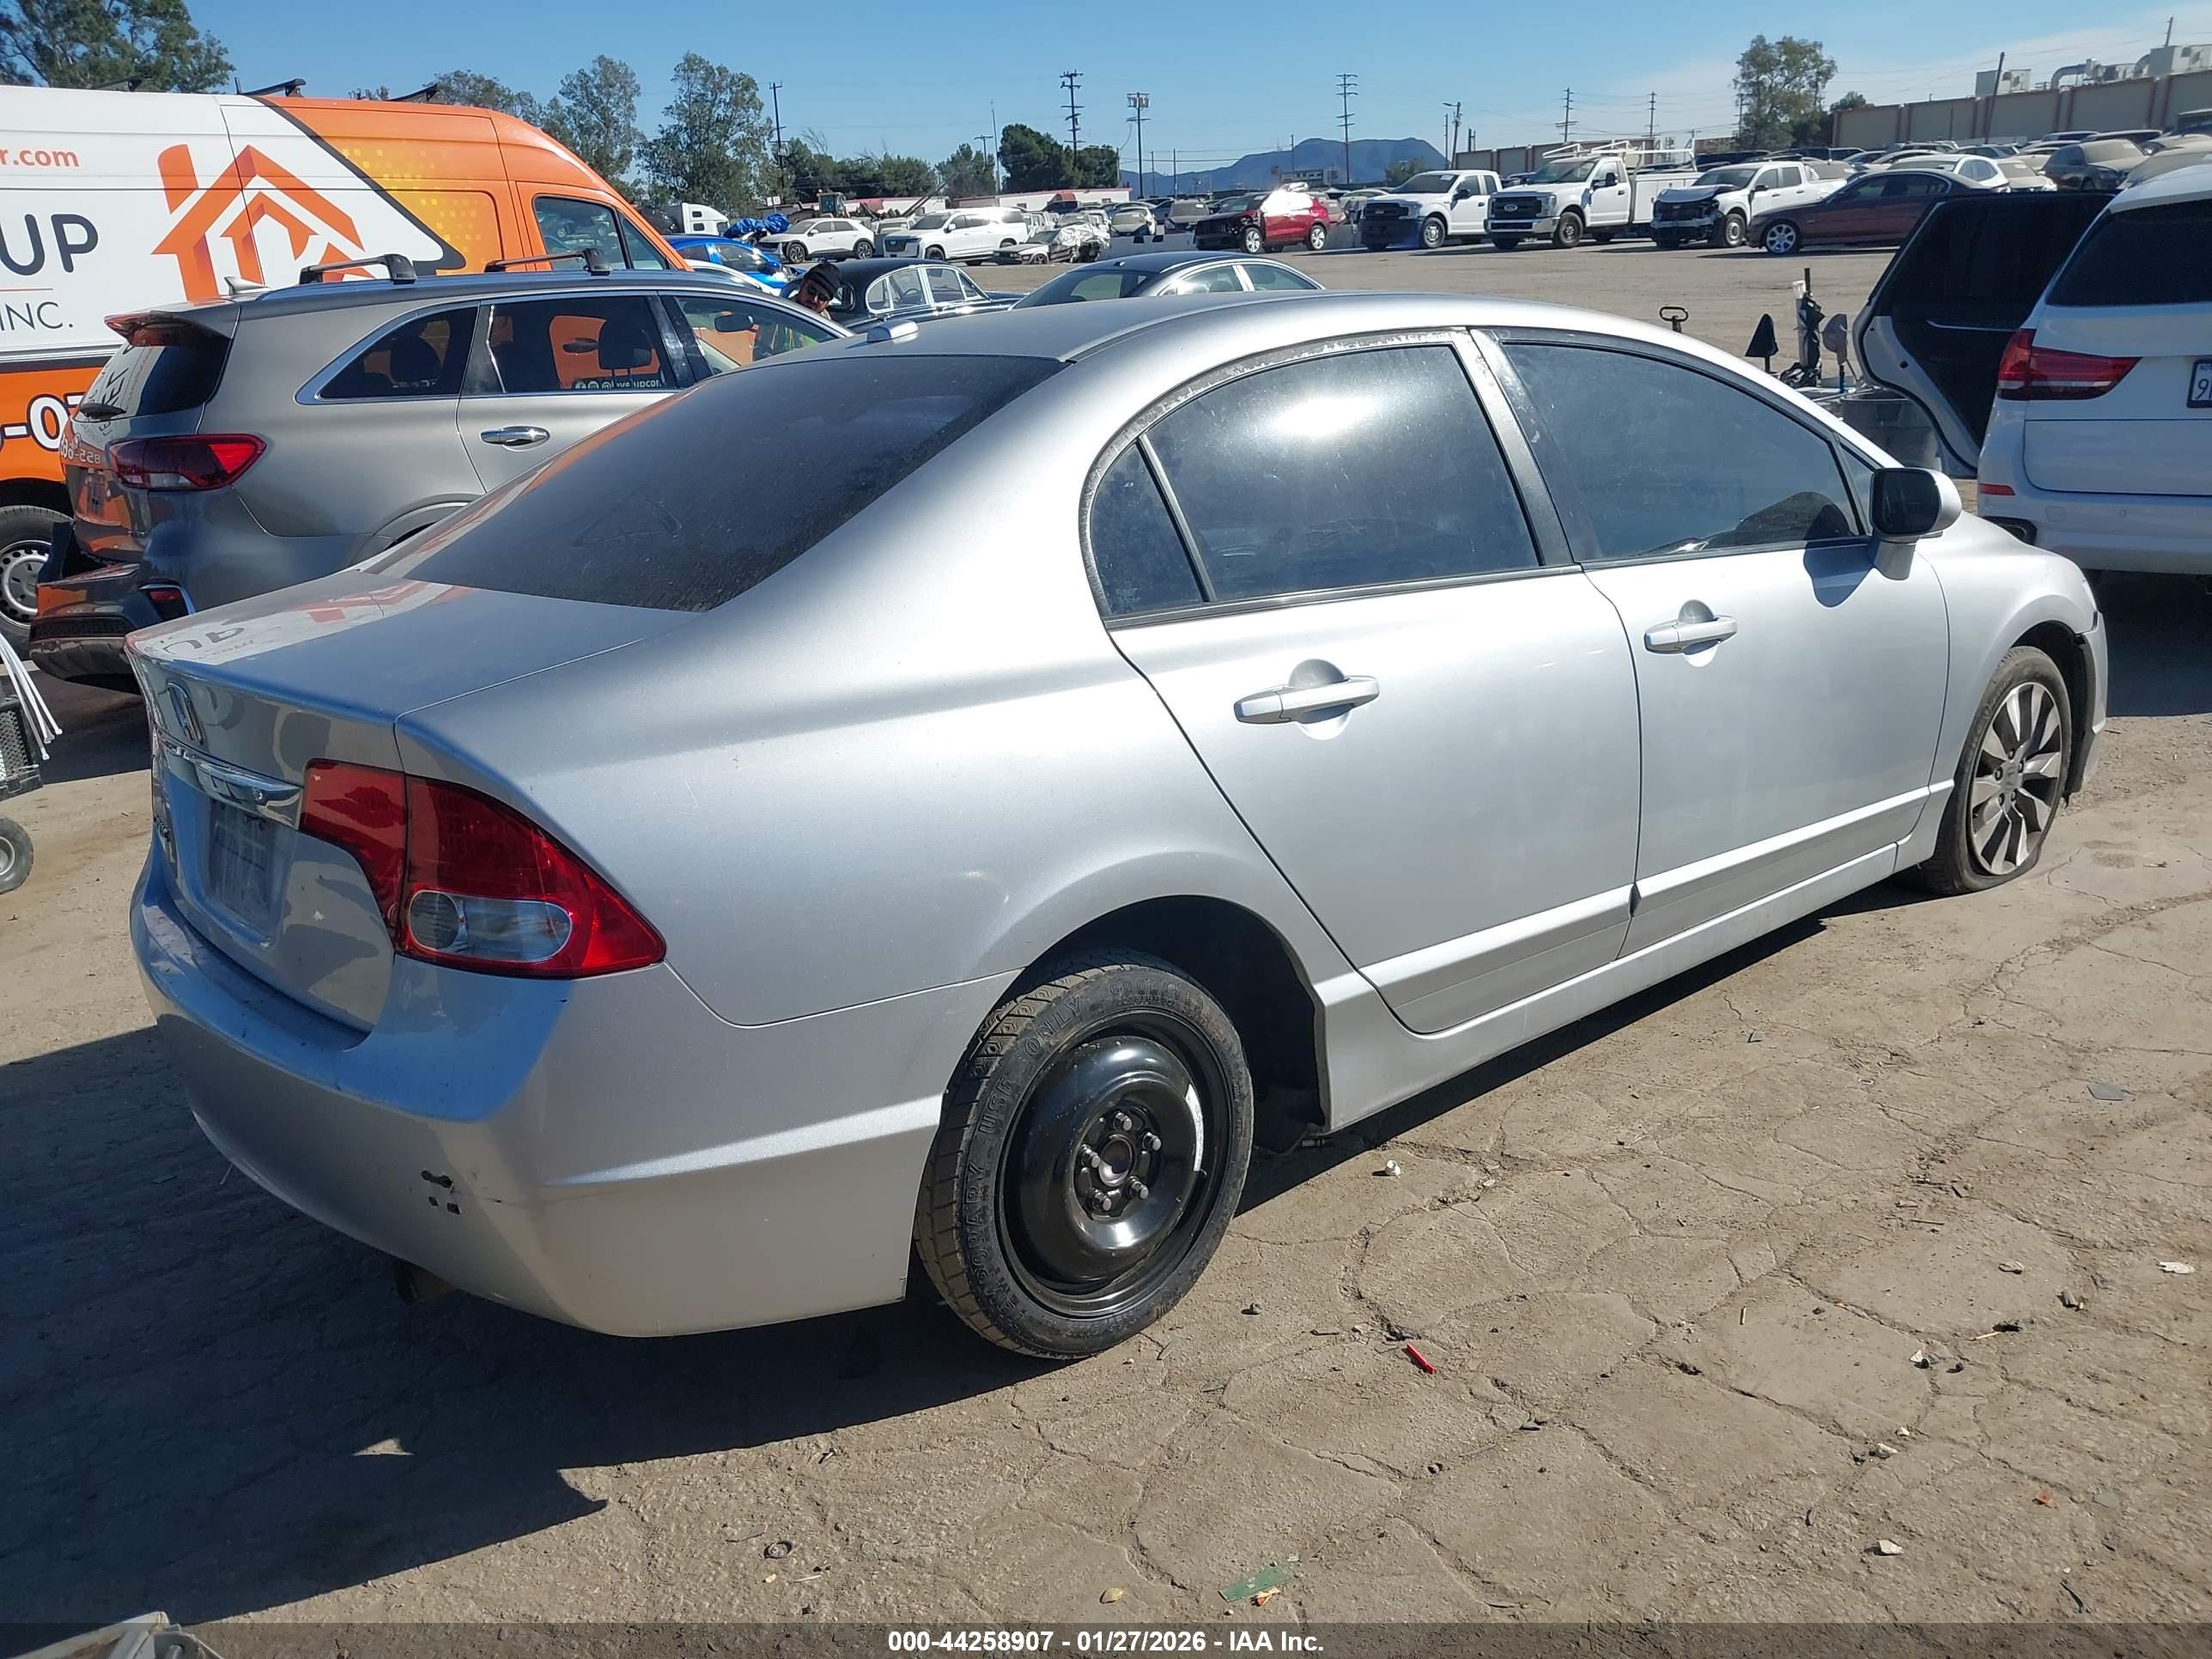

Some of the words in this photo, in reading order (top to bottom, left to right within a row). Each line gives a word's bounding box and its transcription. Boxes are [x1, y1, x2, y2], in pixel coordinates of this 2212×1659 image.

[0, 214, 99, 276] UP
[979, 1075, 1013, 1137] USE
[1023, 994, 1081, 1057] ONLY
